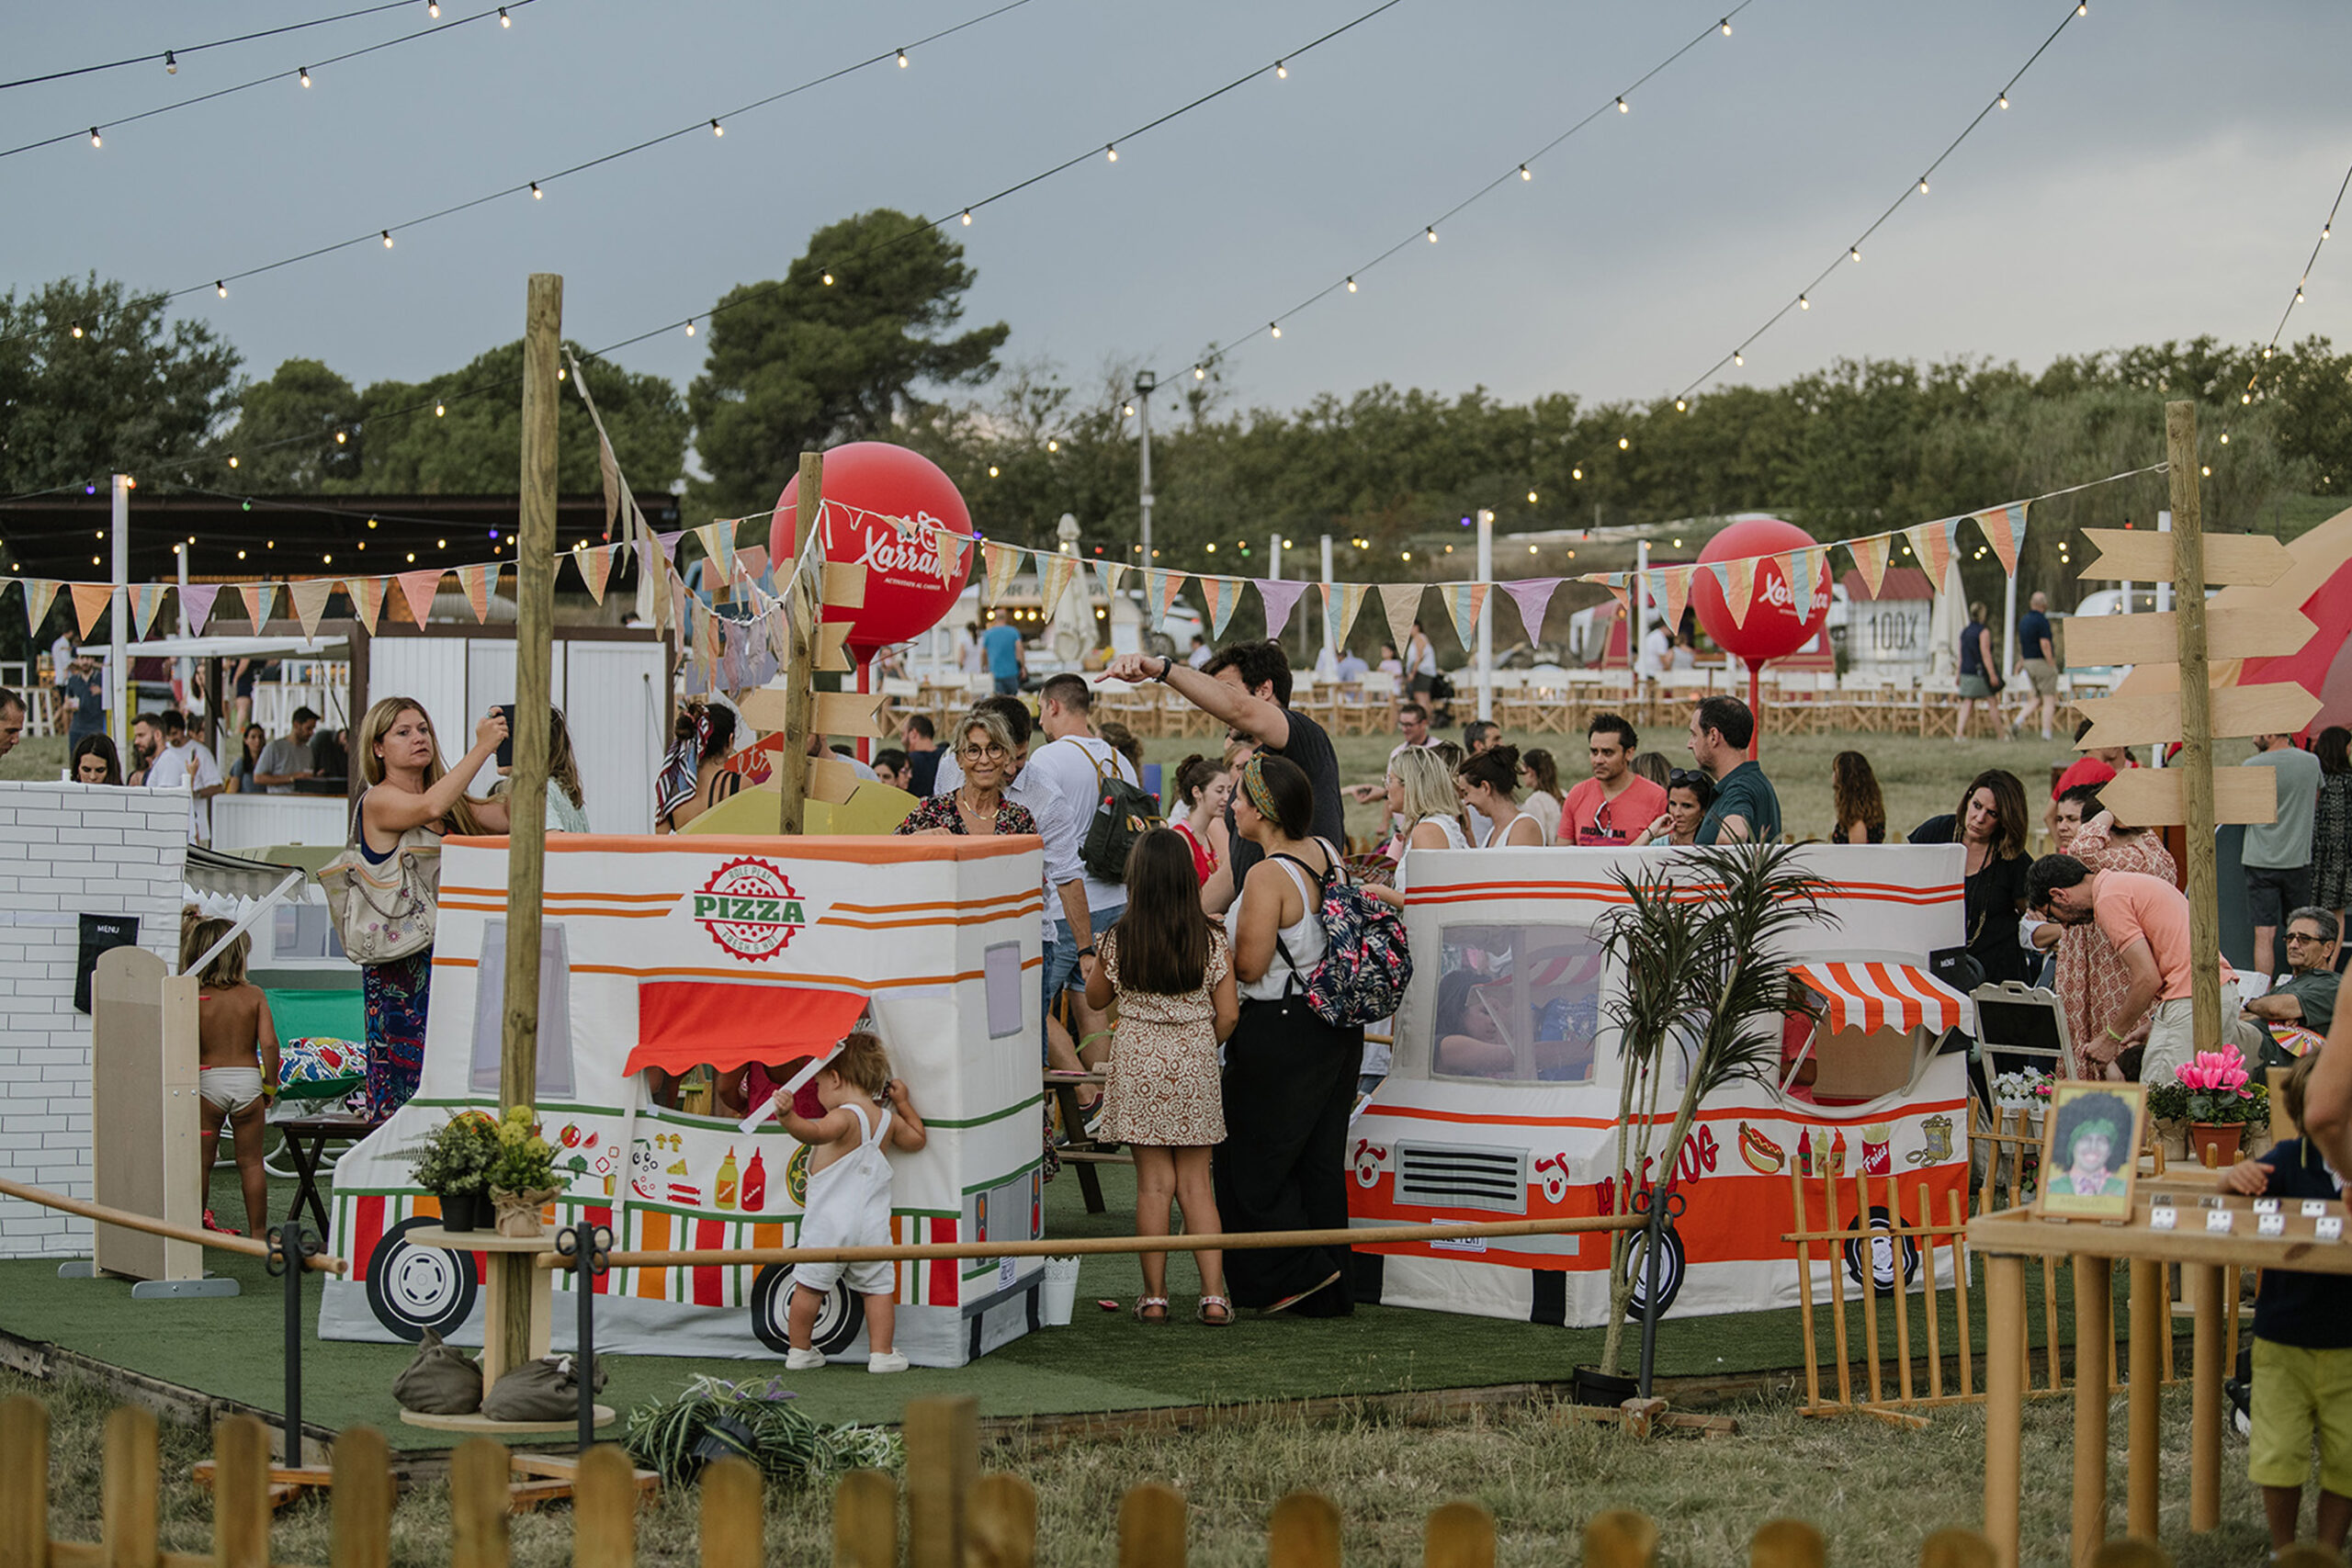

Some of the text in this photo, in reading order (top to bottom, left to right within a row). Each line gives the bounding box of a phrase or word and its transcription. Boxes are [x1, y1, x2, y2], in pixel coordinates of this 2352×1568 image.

[1868, 611, 1919, 650] 100%
[1580, 826, 1626, 839] IROAN
[729, 866, 773, 881] ROLE PLAY
[694, 896, 806, 923] PIZZA
[96, 924, 120, 934] MENU
[721, 931, 751, 953] FRESH
[763, 935, 779, 952] HOT
[1862, 1145, 1888, 1174] Fries
